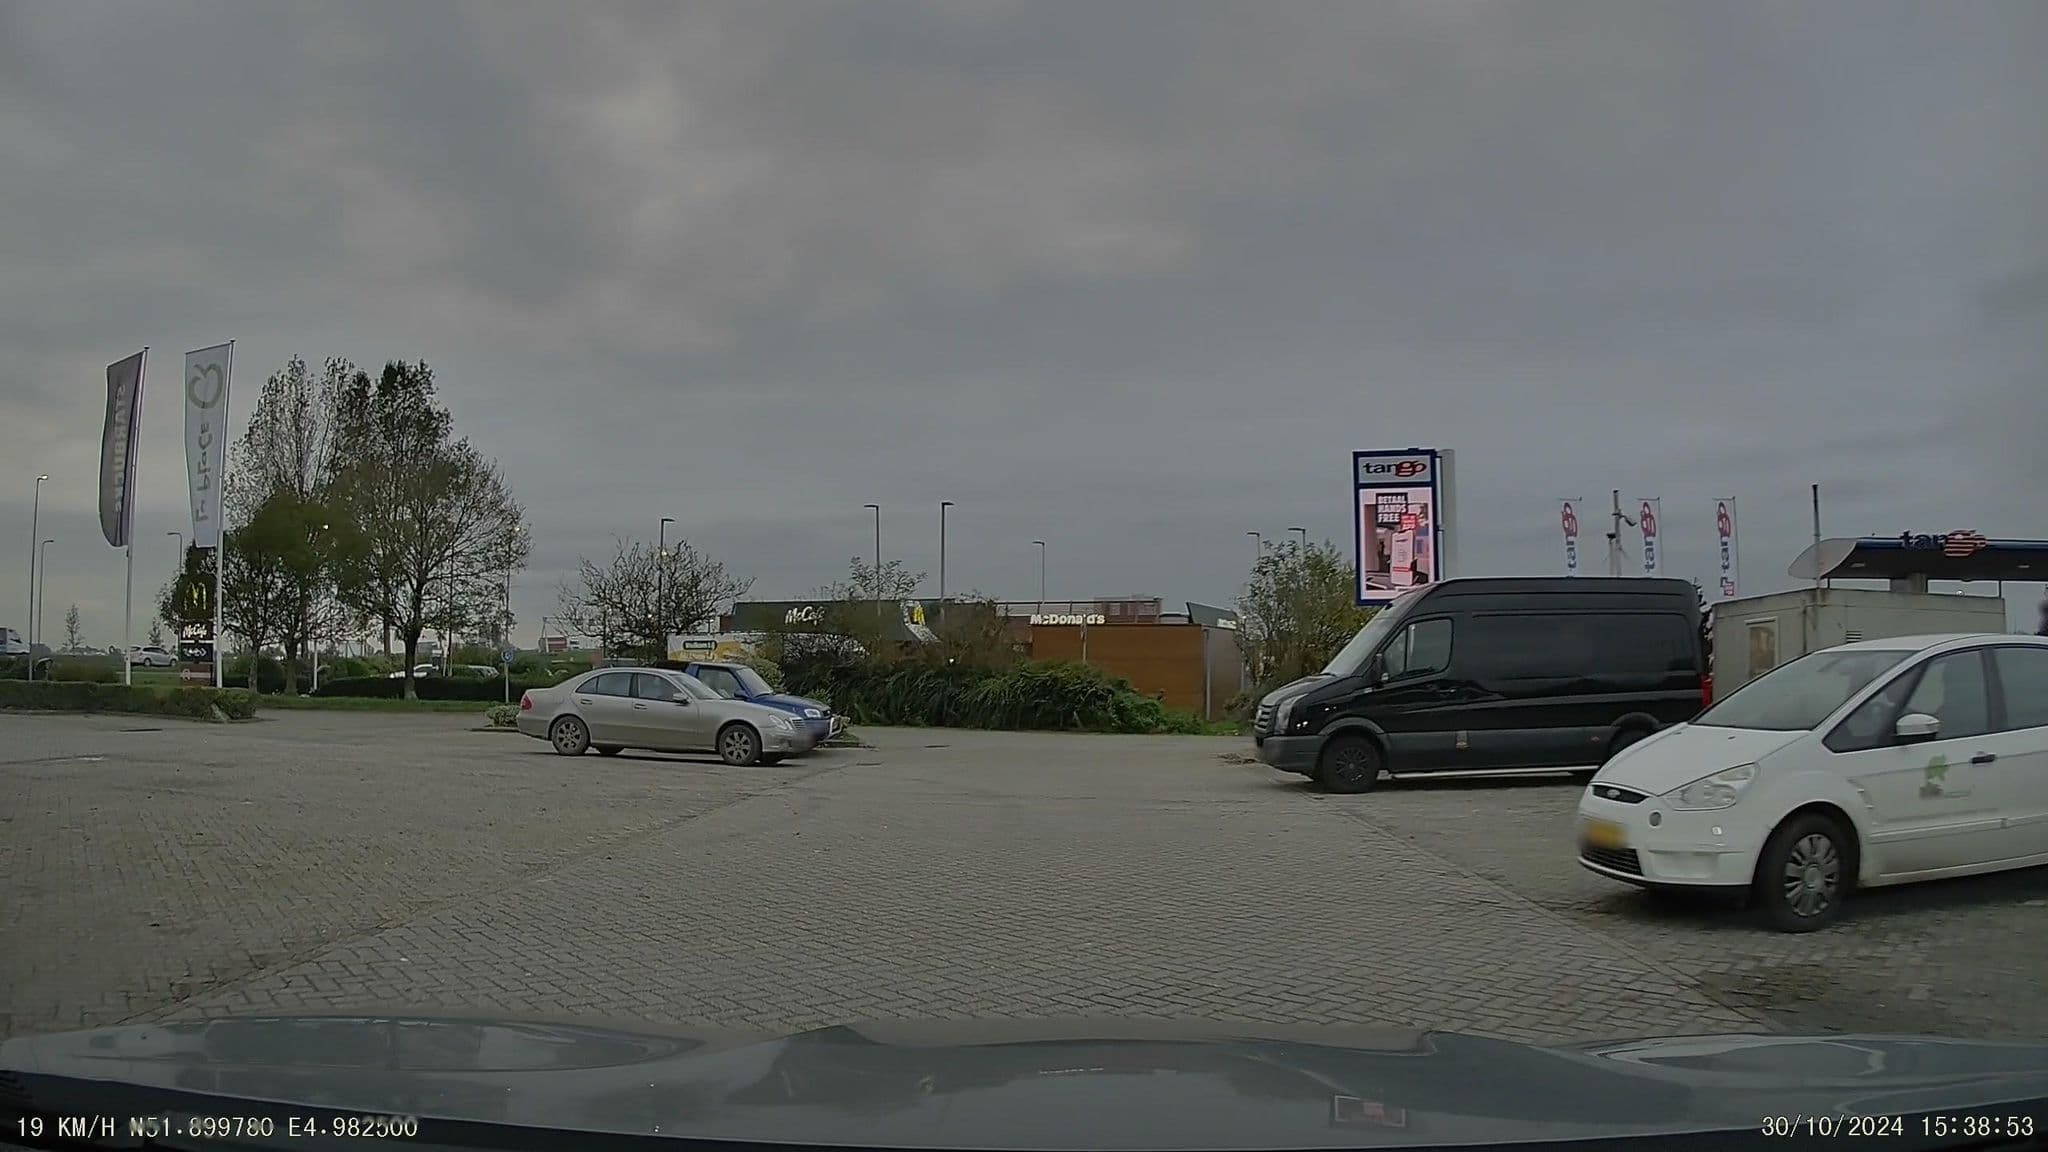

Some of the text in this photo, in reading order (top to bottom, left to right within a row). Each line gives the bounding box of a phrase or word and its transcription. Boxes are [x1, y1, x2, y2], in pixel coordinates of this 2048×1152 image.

[1363, 461, 1427, 477] tango
[1377, 503, 1406, 513] HANDS
[1377, 513, 1400, 523] FREE
[1561, 501, 1578, 572] tango
[1640, 501, 1656, 573] tango
[1717, 501, 1732, 574] tango
[1900, 529, 1986, 557] tango
